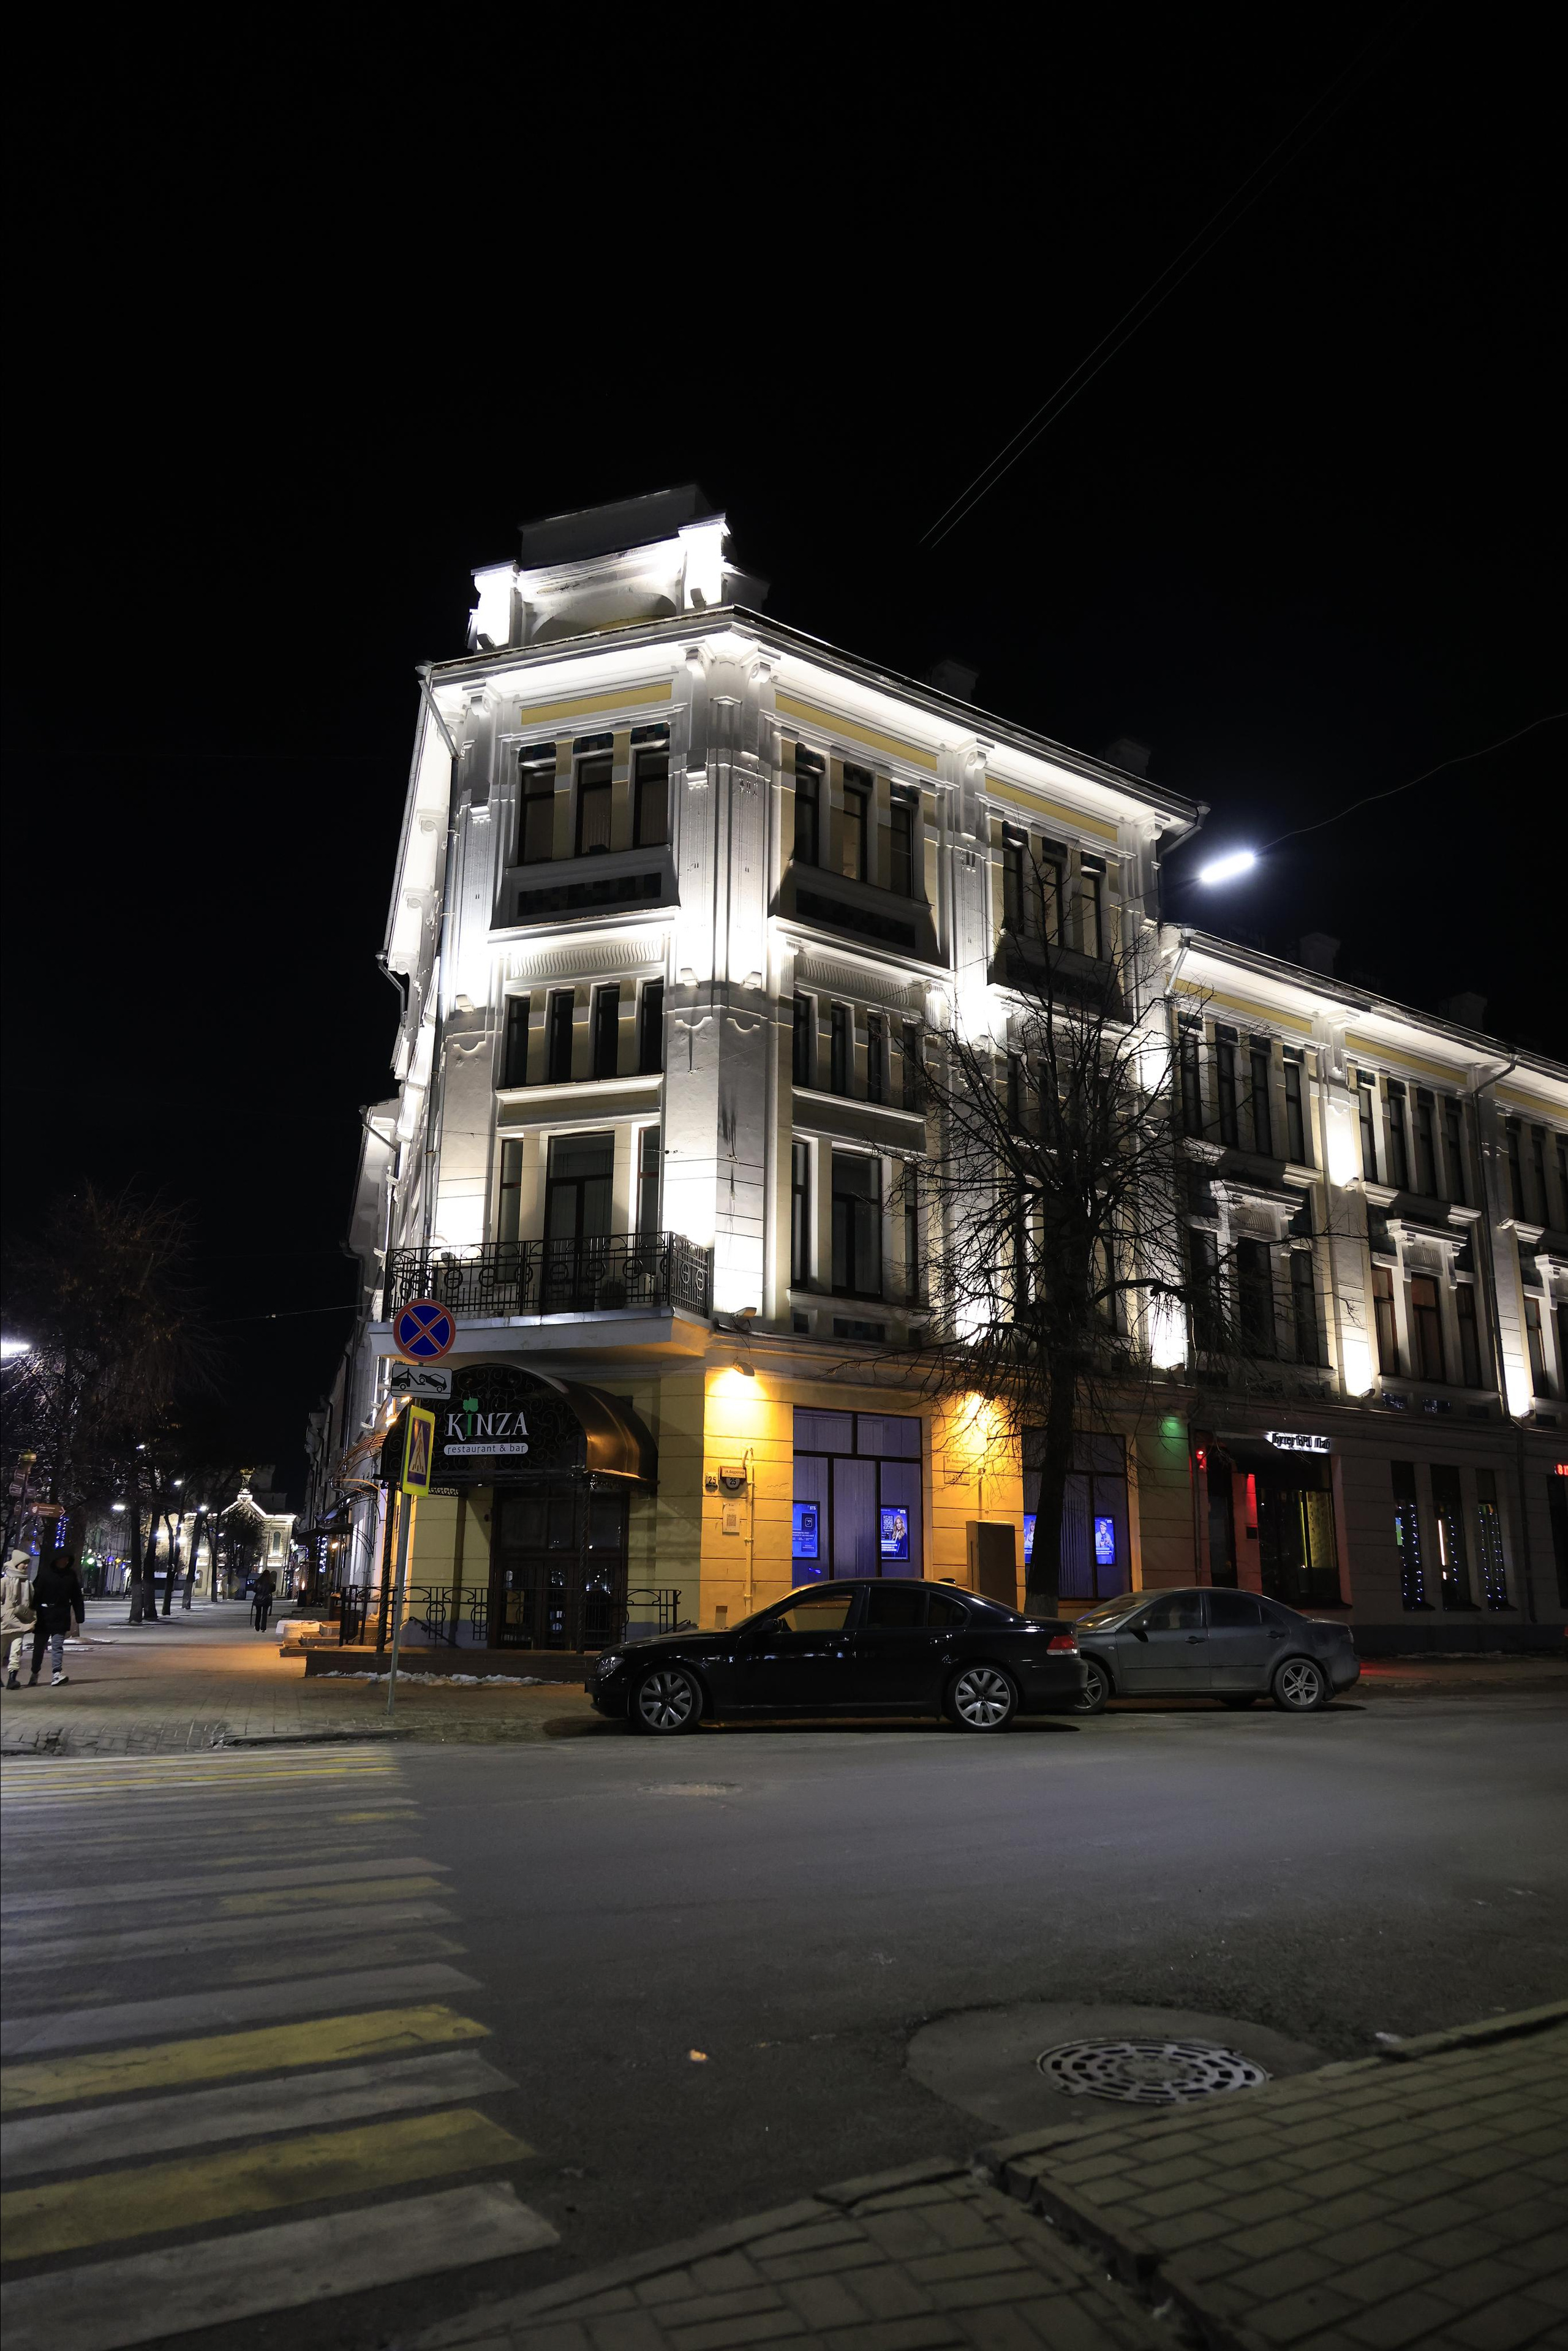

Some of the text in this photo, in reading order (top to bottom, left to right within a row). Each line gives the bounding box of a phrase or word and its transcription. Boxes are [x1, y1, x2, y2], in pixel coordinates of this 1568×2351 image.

[445, 1411, 529, 1441] KINZA
[448, 1444, 496, 1454] restaurant
[510, 1444, 525, 1453] bar
[708, 1476, 716, 1484] 25
